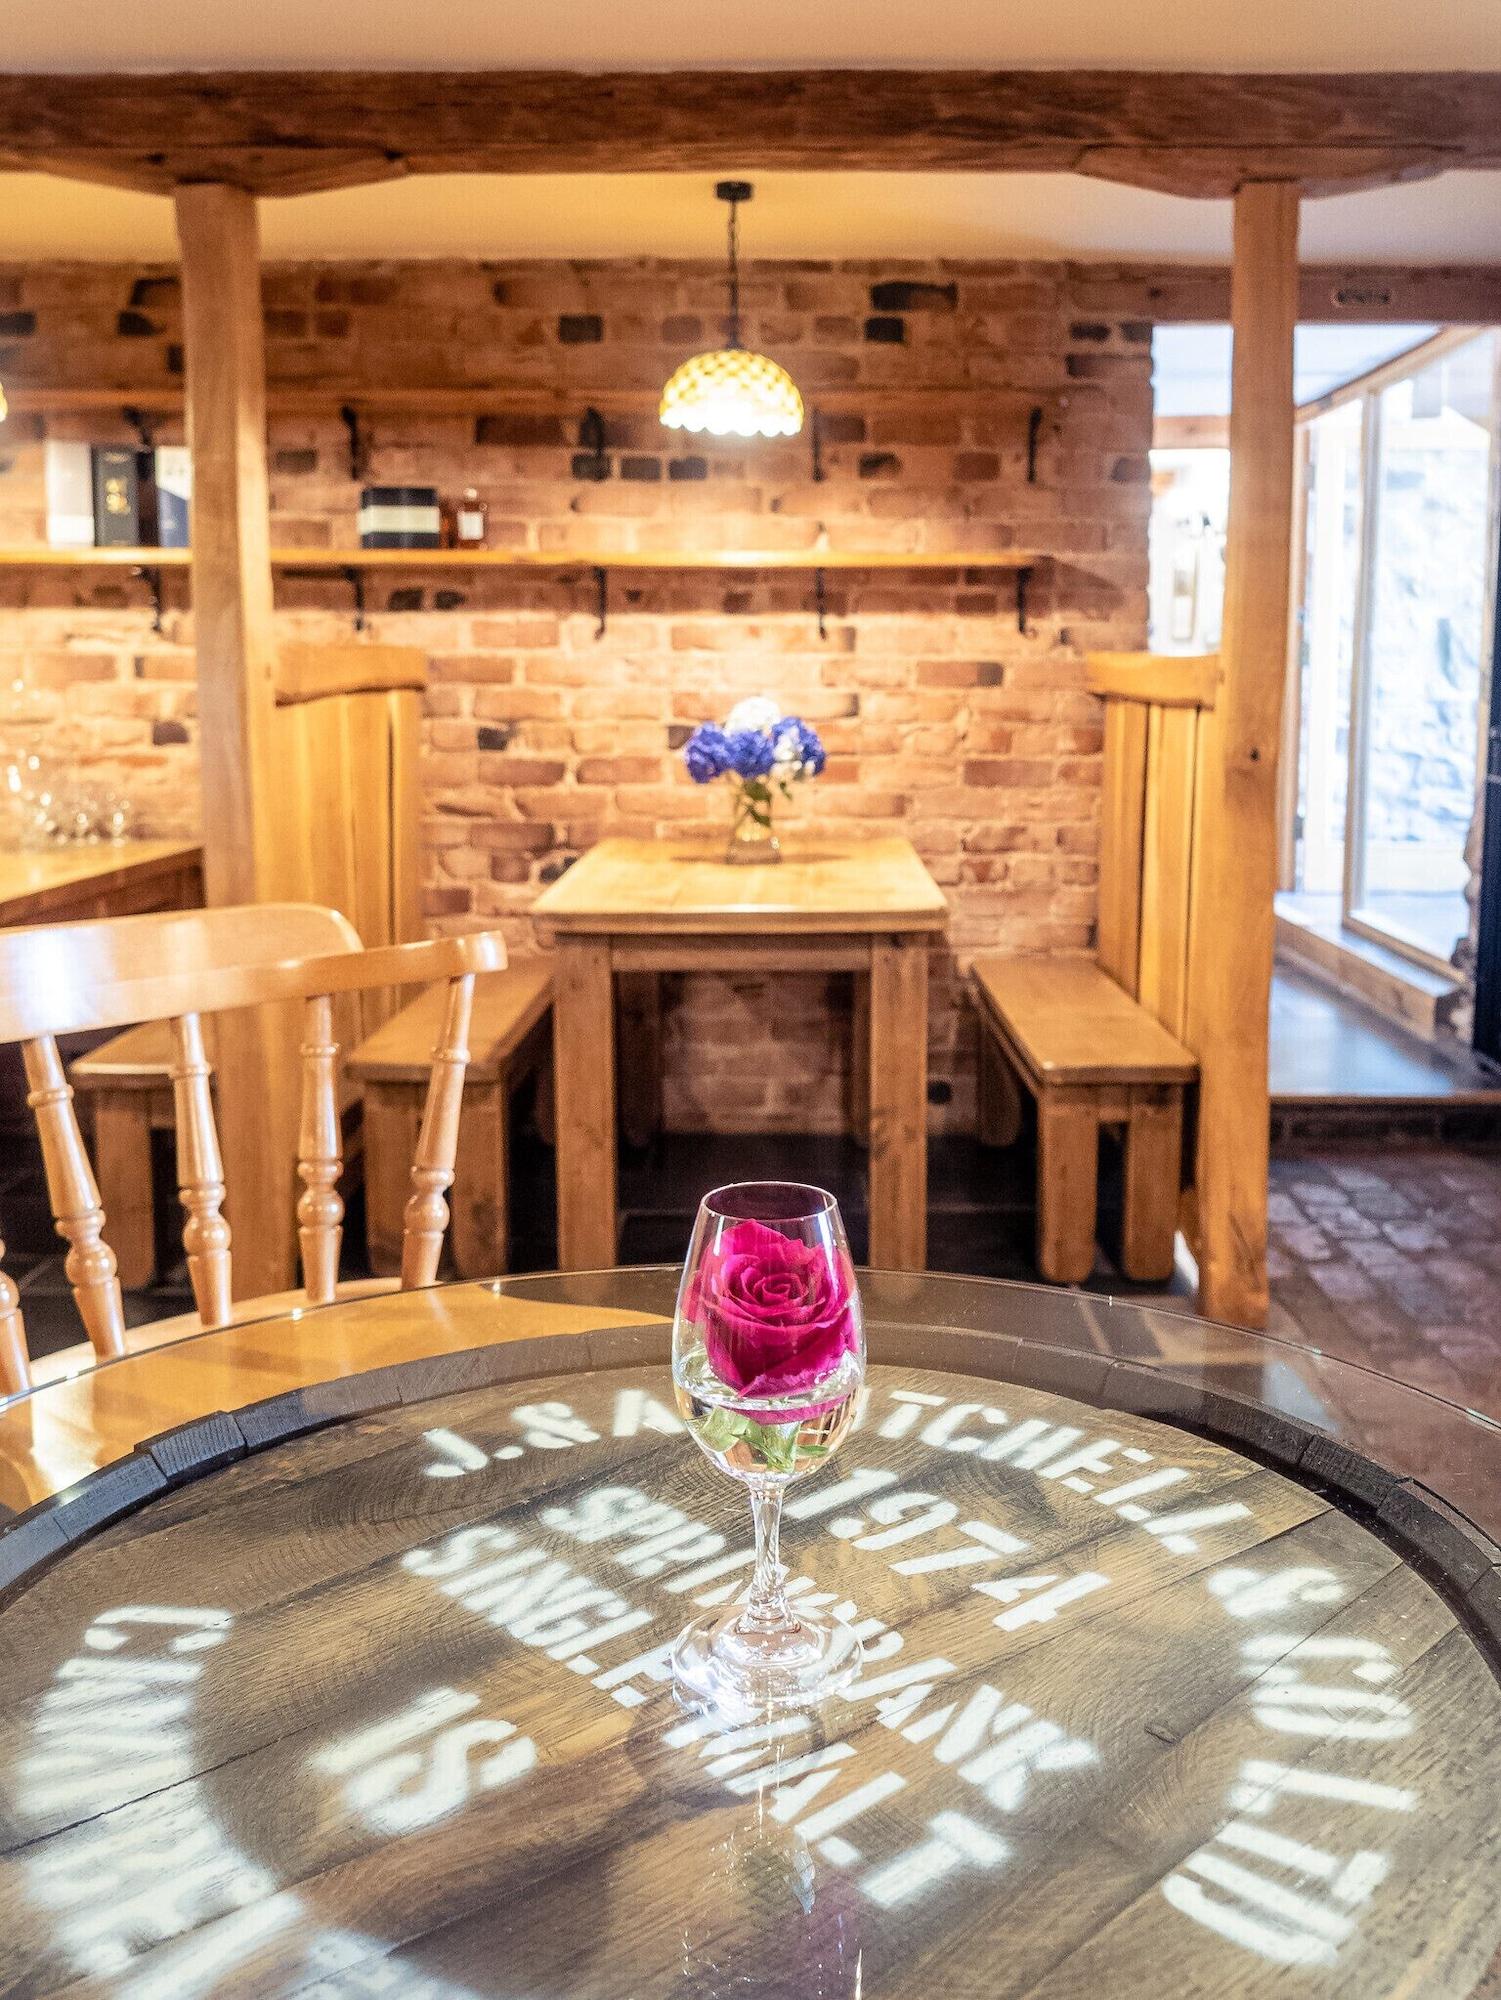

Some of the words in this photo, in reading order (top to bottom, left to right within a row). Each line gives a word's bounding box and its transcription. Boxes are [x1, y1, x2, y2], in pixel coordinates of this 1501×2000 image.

[510, 1402, 601, 1449] &
[850, 1388, 1254, 1555] TCHELL
[783, 1467, 1111, 1632] 1974
[1205, 1566, 1348, 1620] &
[401, 1525, 695, 1708] SINGLE
[661, 1702, 1010, 1908] MALT
[1237, 1633, 1416, 1740] CO
[1161, 1759, 1418, 1965] LTD
